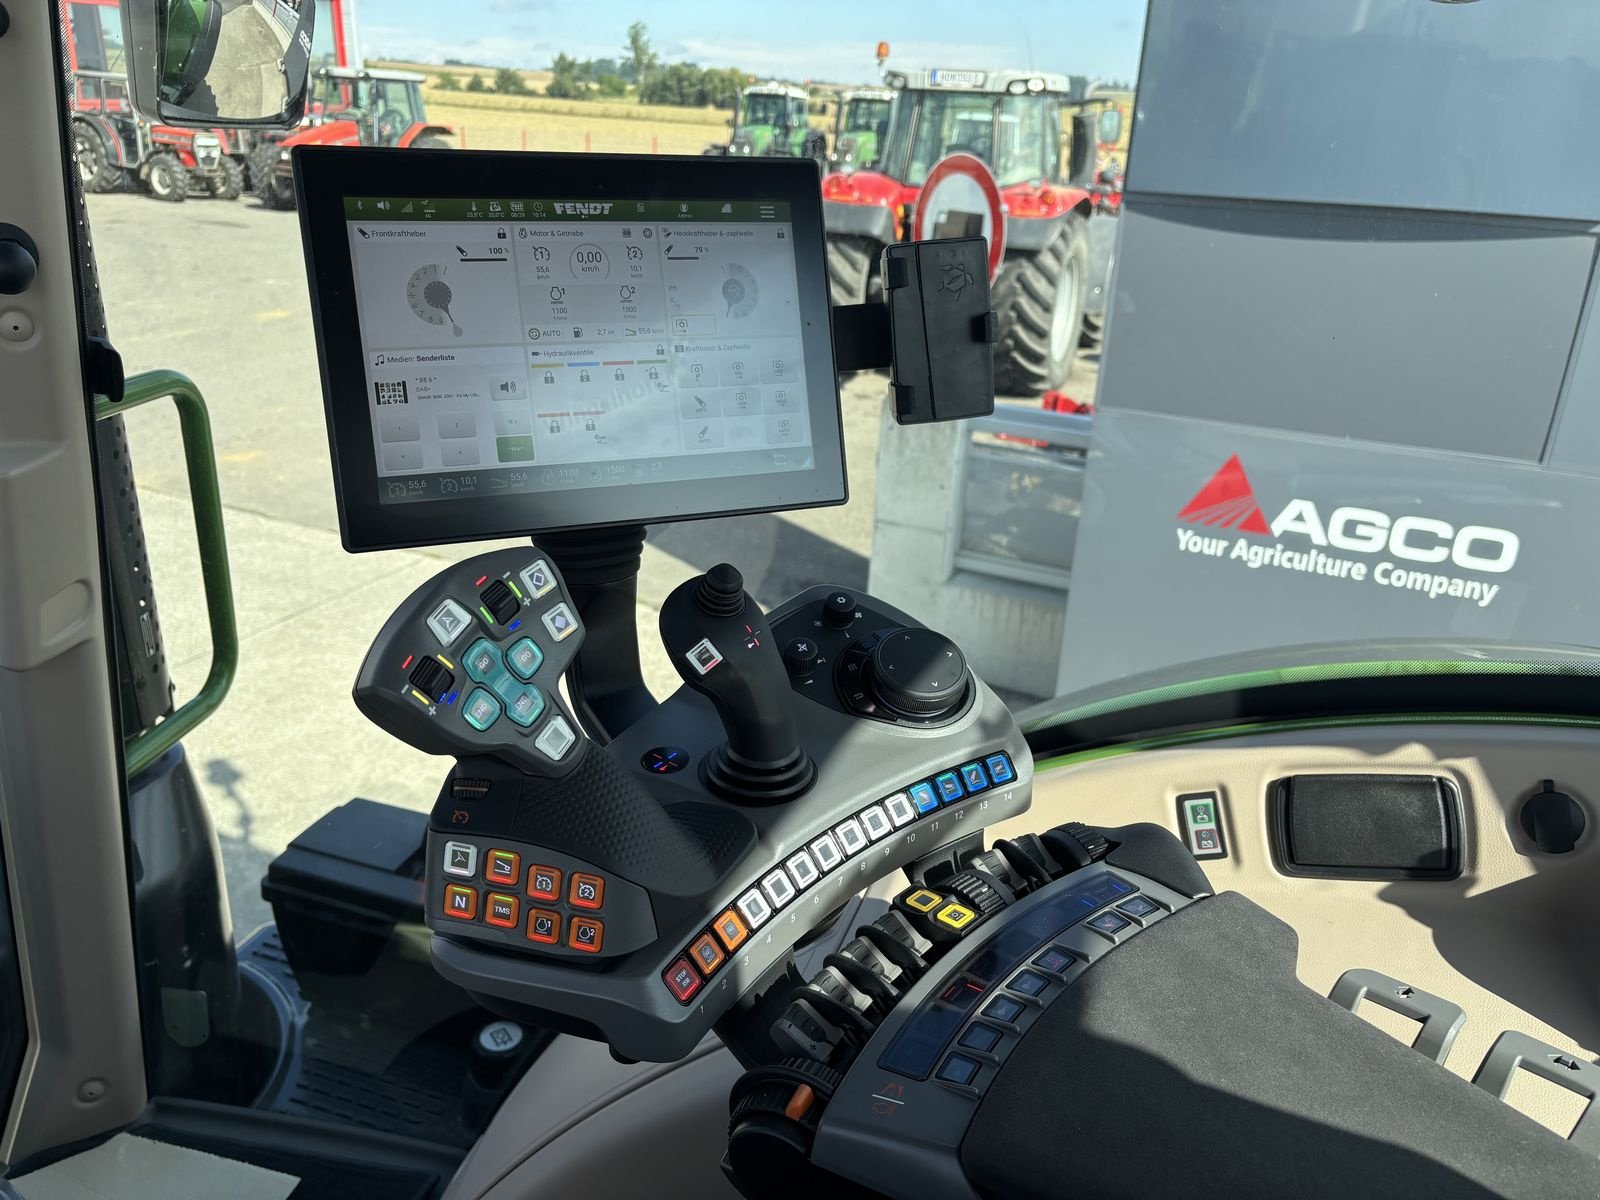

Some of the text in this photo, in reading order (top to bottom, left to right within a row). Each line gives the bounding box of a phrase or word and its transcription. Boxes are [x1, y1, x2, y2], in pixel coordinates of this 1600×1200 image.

[553, 202, 613, 215] FENDT
[371, 230, 426, 238] Frontkraftheber
[556, 230, 584, 238] Getriebe
[576, 252, 602, 264] 0,00
[416, 354, 455, 362] Senderliste
[543, 349, 594, 358] Hydraulikventile
[510, 472, 528, 481] 55,6
[560, 468, 579, 477] 1100
[408, 480, 427, 489] 55,6
[461, 476, 477, 485] 10,1
[1271, 498, 1520, 573] AGCO
[1176, 528, 1500, 607] Your Agriculture Company
[521, 652, 531, 662] GO
[479, 657, 489, 669] GO
[515, 695, 528, 711] END
[474, 703, 488, 718] END
[722, 980, 727, 989] 2
[744, 956, 749, 966] 3
[766, 934, 772, 944] 4
[791, 913, 796, 923] 5
[814, 896, 819, 904] 6
[838, 877, 843, 886] 7
[860, 862, 866, 870] 8
[884, 847, 890, 856] 9
[906, 834, 916, 844] 10
[931, 822, 939, 832] 11
[955, 811, 964, 820] 12
[979, 801, 988, 811] 13
[1004, 792, 1013, 801] 14
[455, 895, 466, 909] N
[495, 906, 510, 914] TMS
[676, 969, 686, 982] STOP
